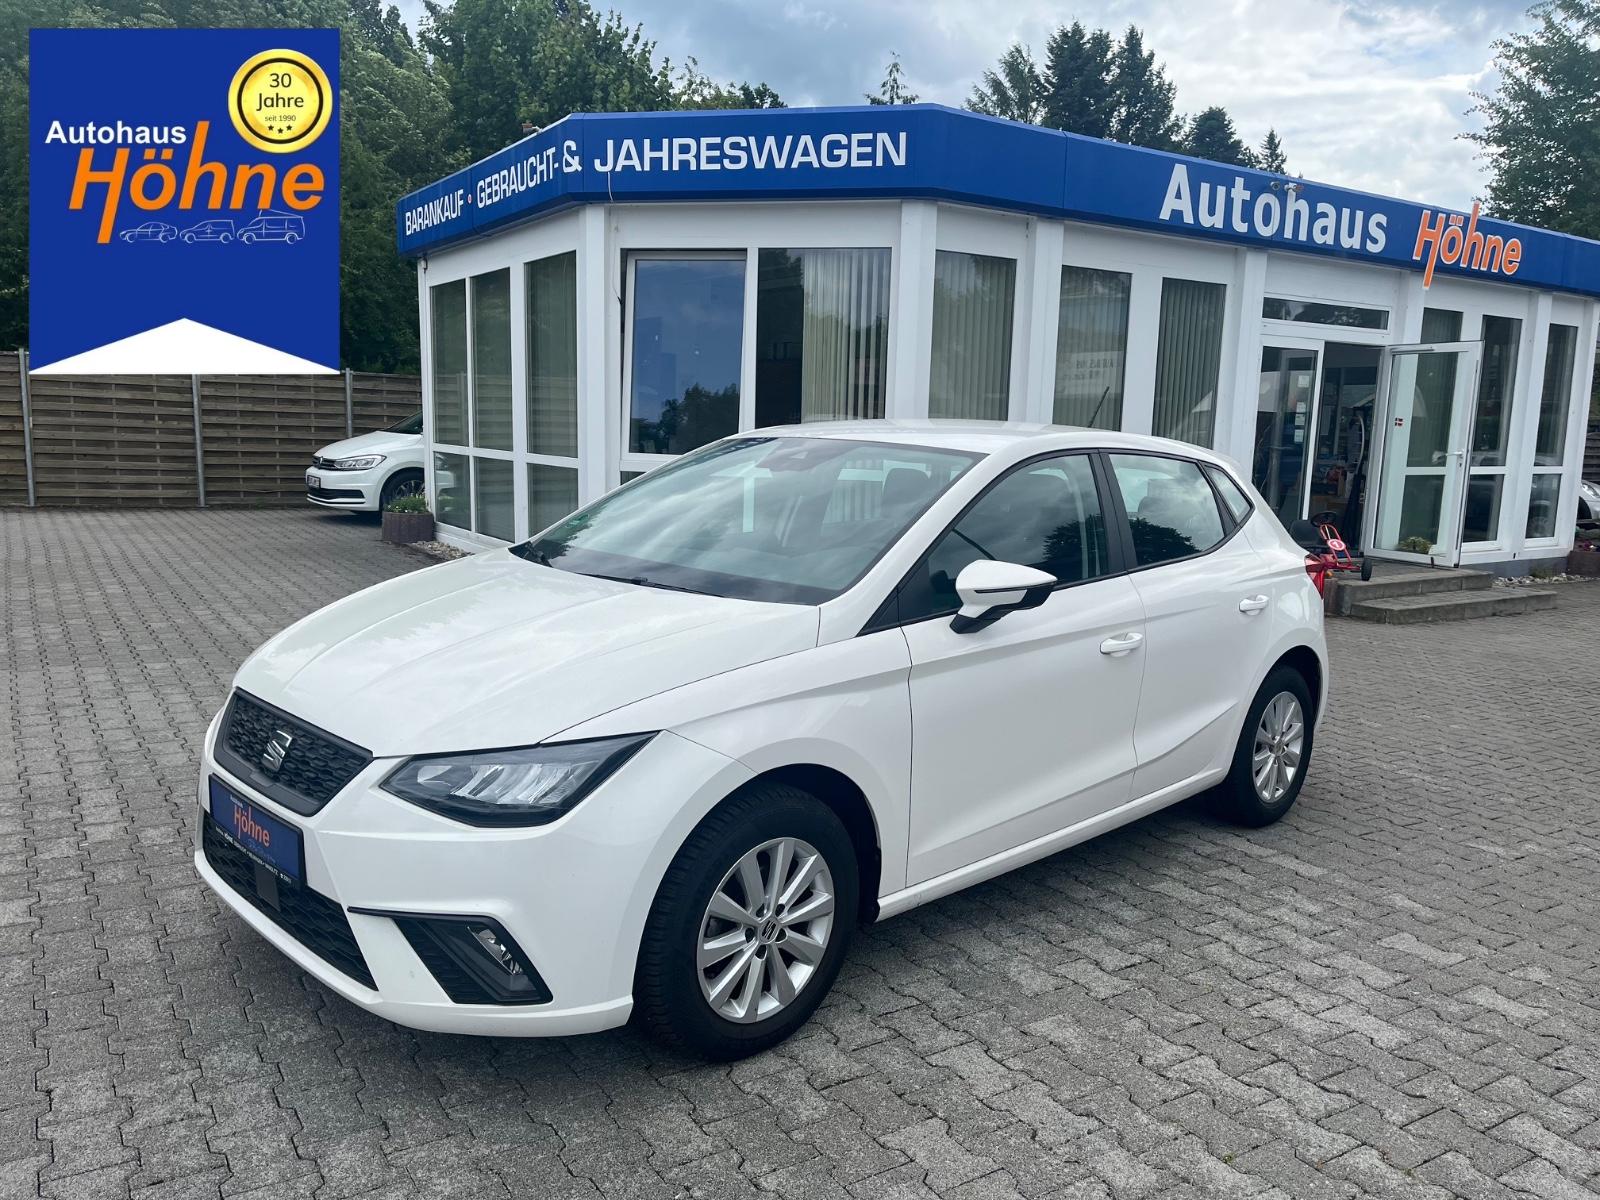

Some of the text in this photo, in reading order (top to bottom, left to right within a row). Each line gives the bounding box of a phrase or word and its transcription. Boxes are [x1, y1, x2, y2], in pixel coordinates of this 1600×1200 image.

[405, 132, 907, 236] BARANKAUF GEBRAUCHT- & JAHRESWAGEN
[1158, 163, 1522, 290] Autohaus Höhne
[233, 804, 270, 848] Höhne
